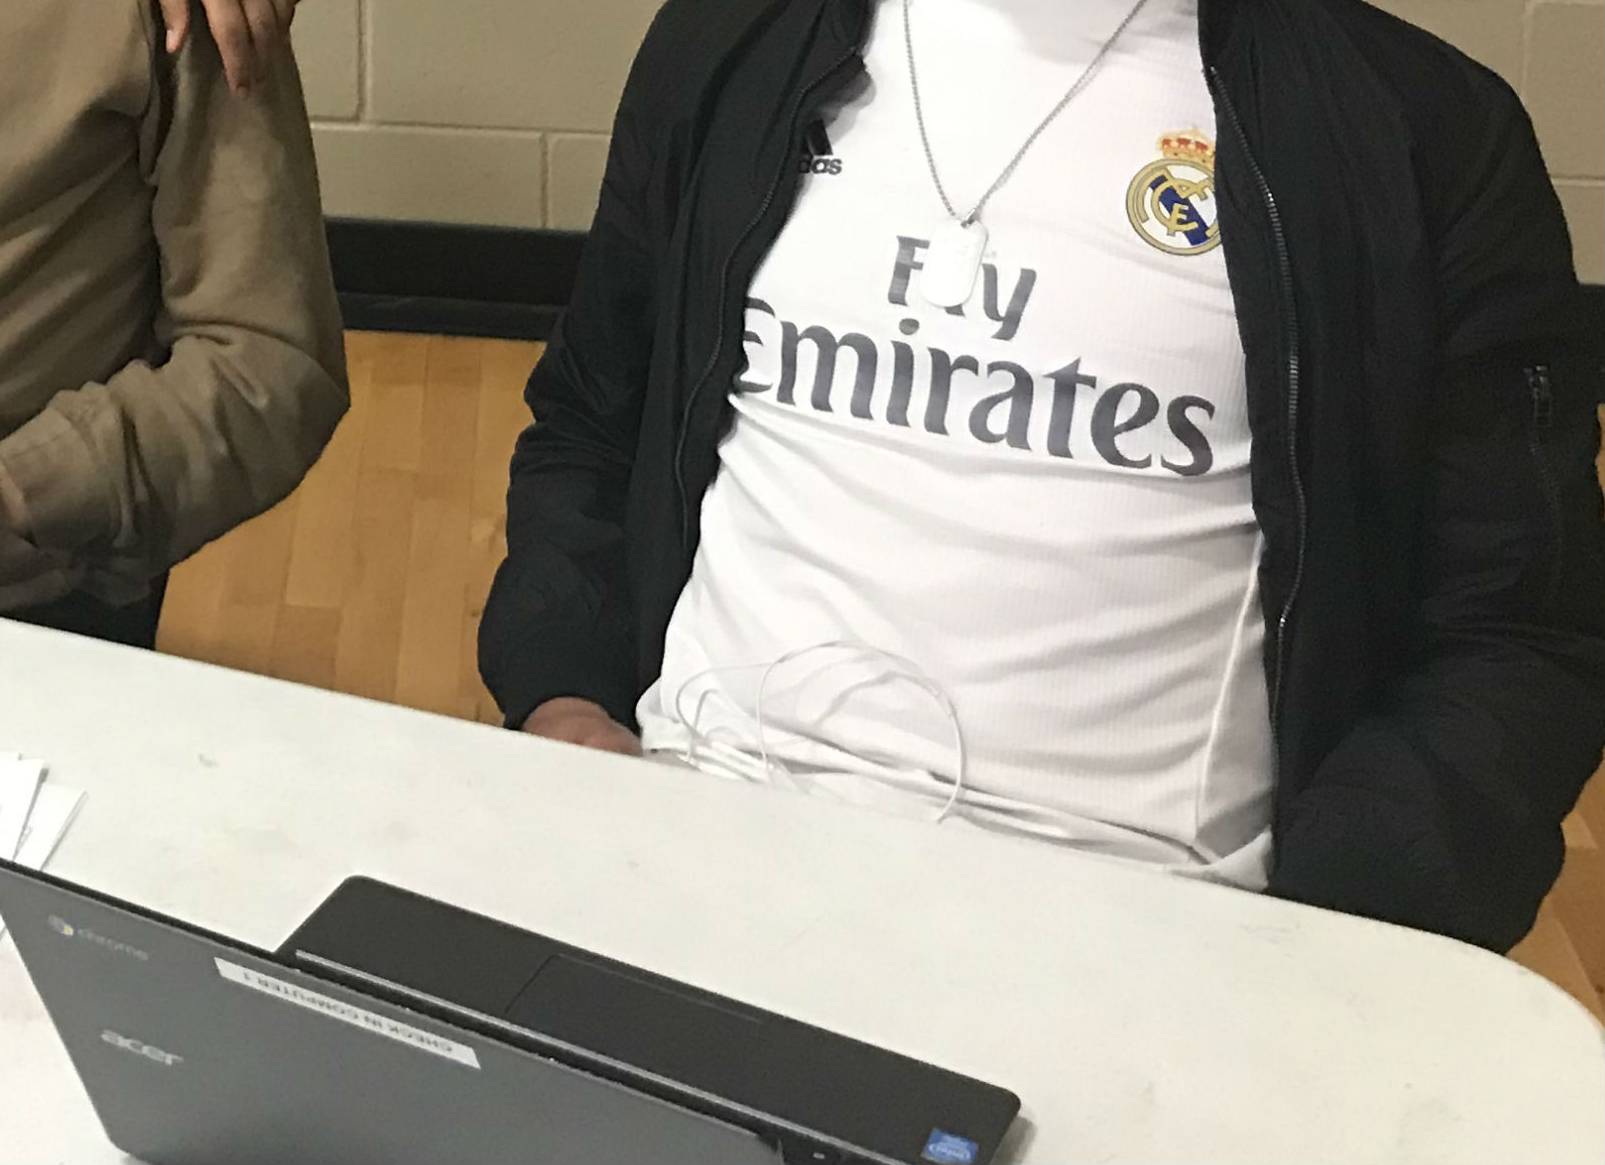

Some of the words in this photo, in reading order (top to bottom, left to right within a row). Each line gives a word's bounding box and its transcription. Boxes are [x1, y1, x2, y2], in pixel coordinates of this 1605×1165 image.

[887, 235, 1038, 342] Fy
[734, 296, 1216, 477] Emirates
[101, 1030, 183, 1066] acer
